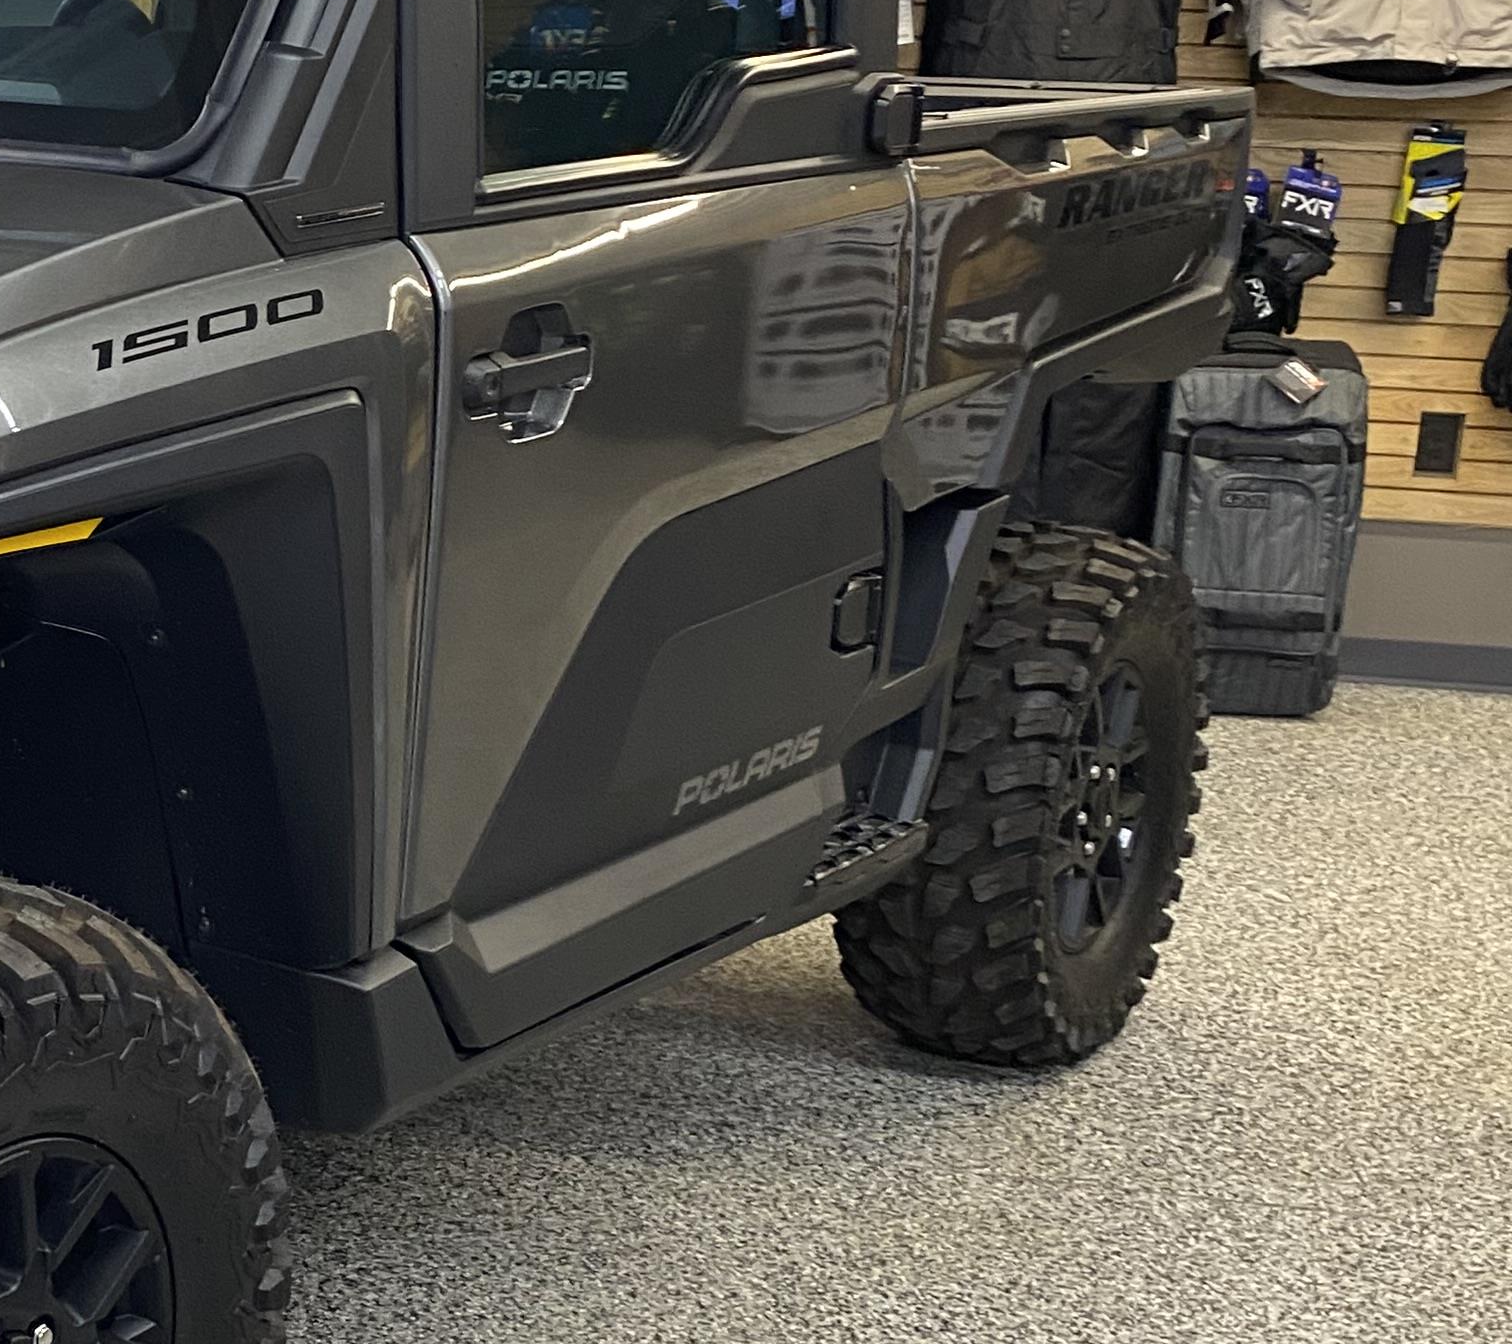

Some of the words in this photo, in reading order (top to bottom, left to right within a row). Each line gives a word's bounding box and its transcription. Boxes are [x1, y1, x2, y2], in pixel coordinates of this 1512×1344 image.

[486, 69, 629, 91] POLARIS
[1056, 159, 1211, 229] RANGER
[1280, 191, 1336, 220] FXR
[1244, 277, 1274, 319] FXR
[91, 288, 324, 372] 1500
[672, 725, 825, 816] POLARIS
